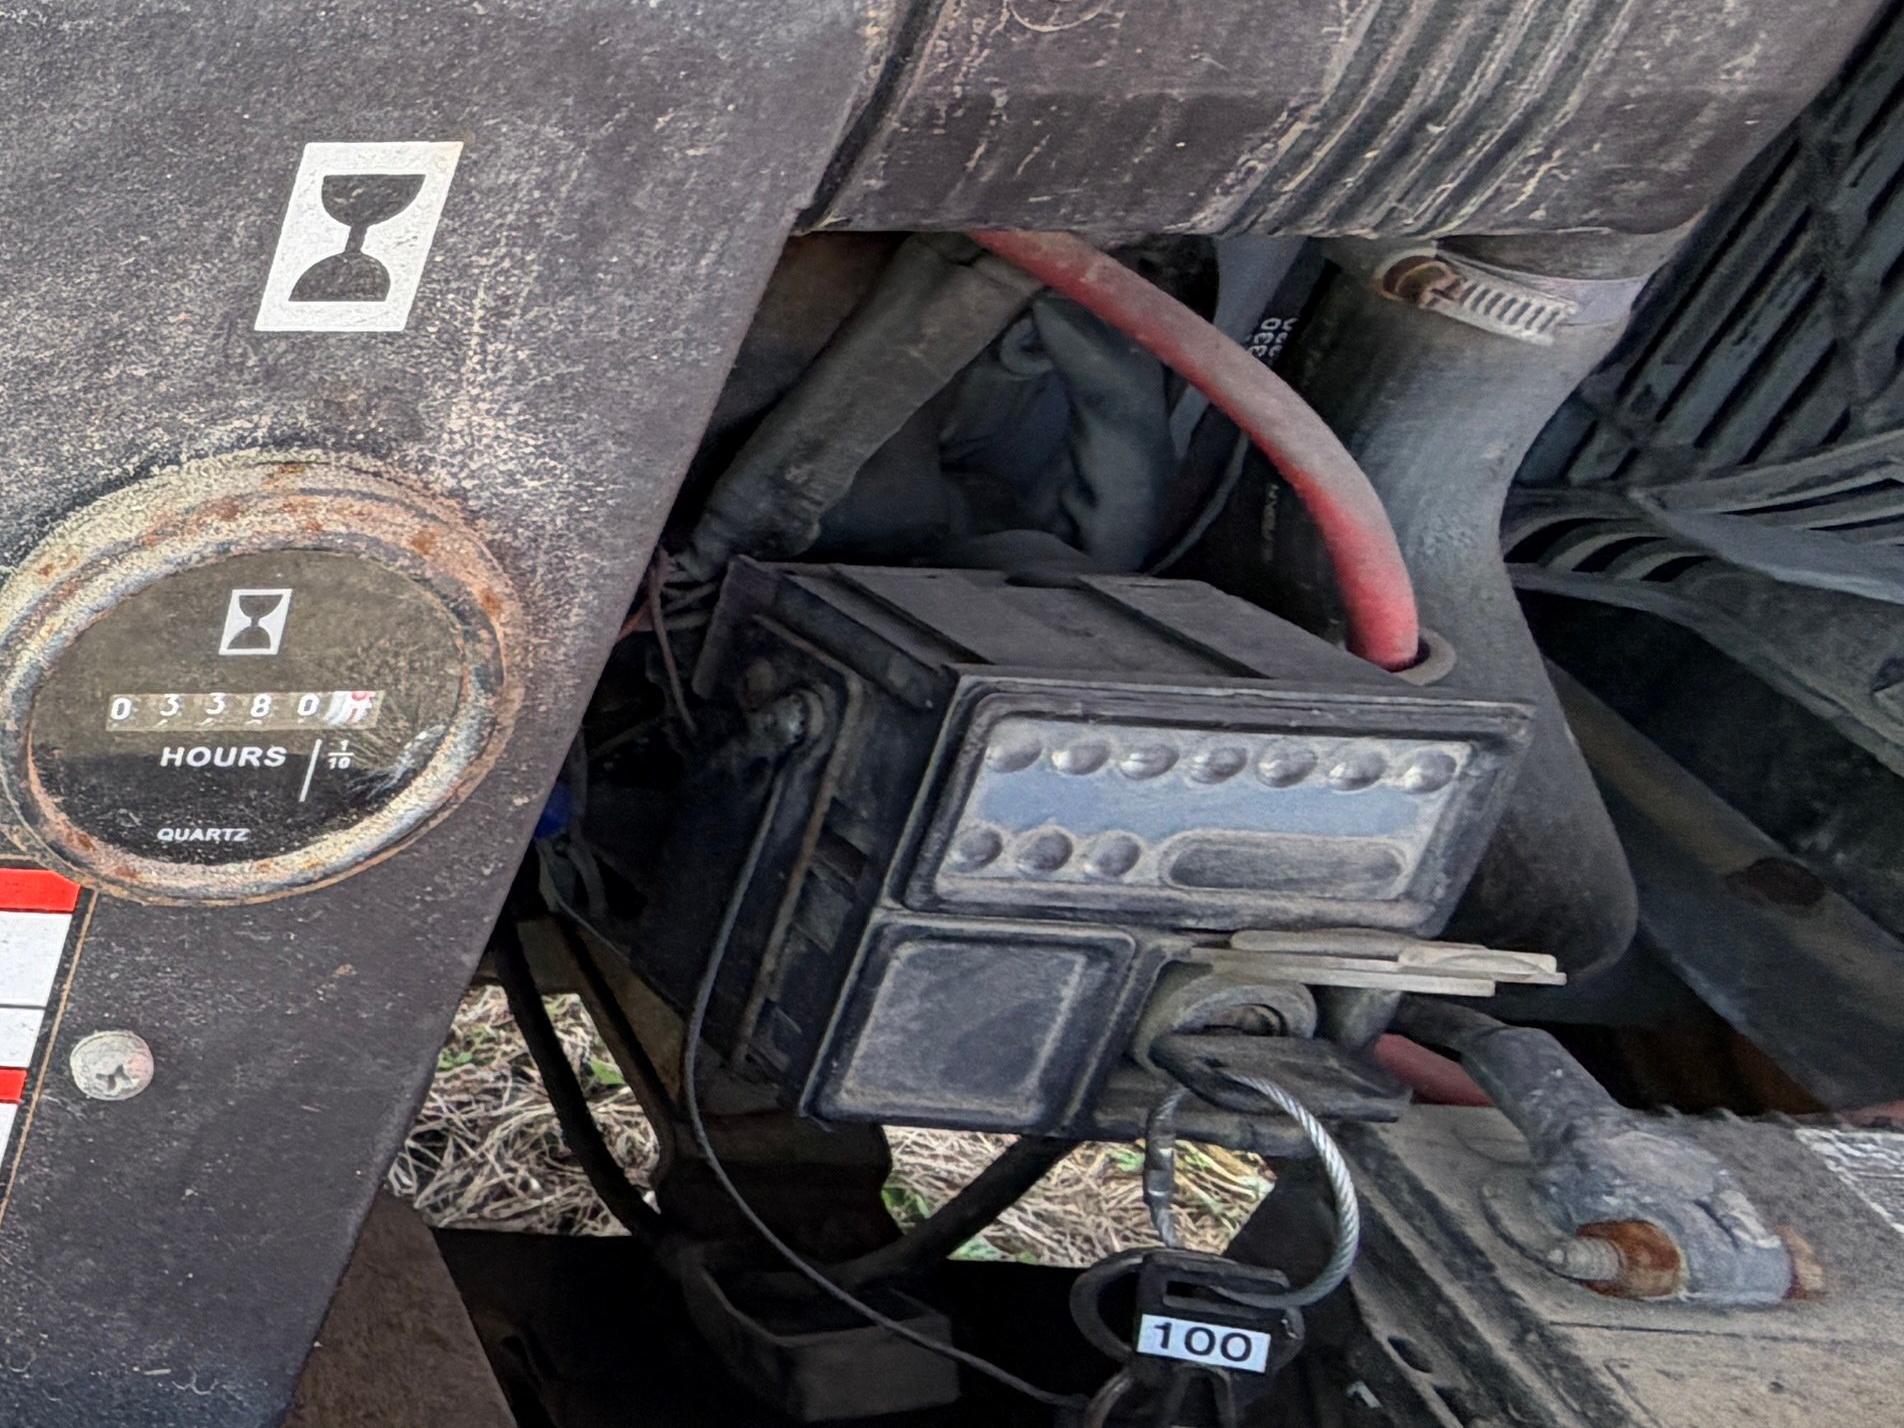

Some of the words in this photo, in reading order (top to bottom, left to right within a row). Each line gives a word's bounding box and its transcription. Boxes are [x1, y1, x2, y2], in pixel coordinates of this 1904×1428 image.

[159, 746, 288, 768] HOURS
[157, 827, 250, 842] QUARTZ
[1153, 1321, 1253, 1362] 100
